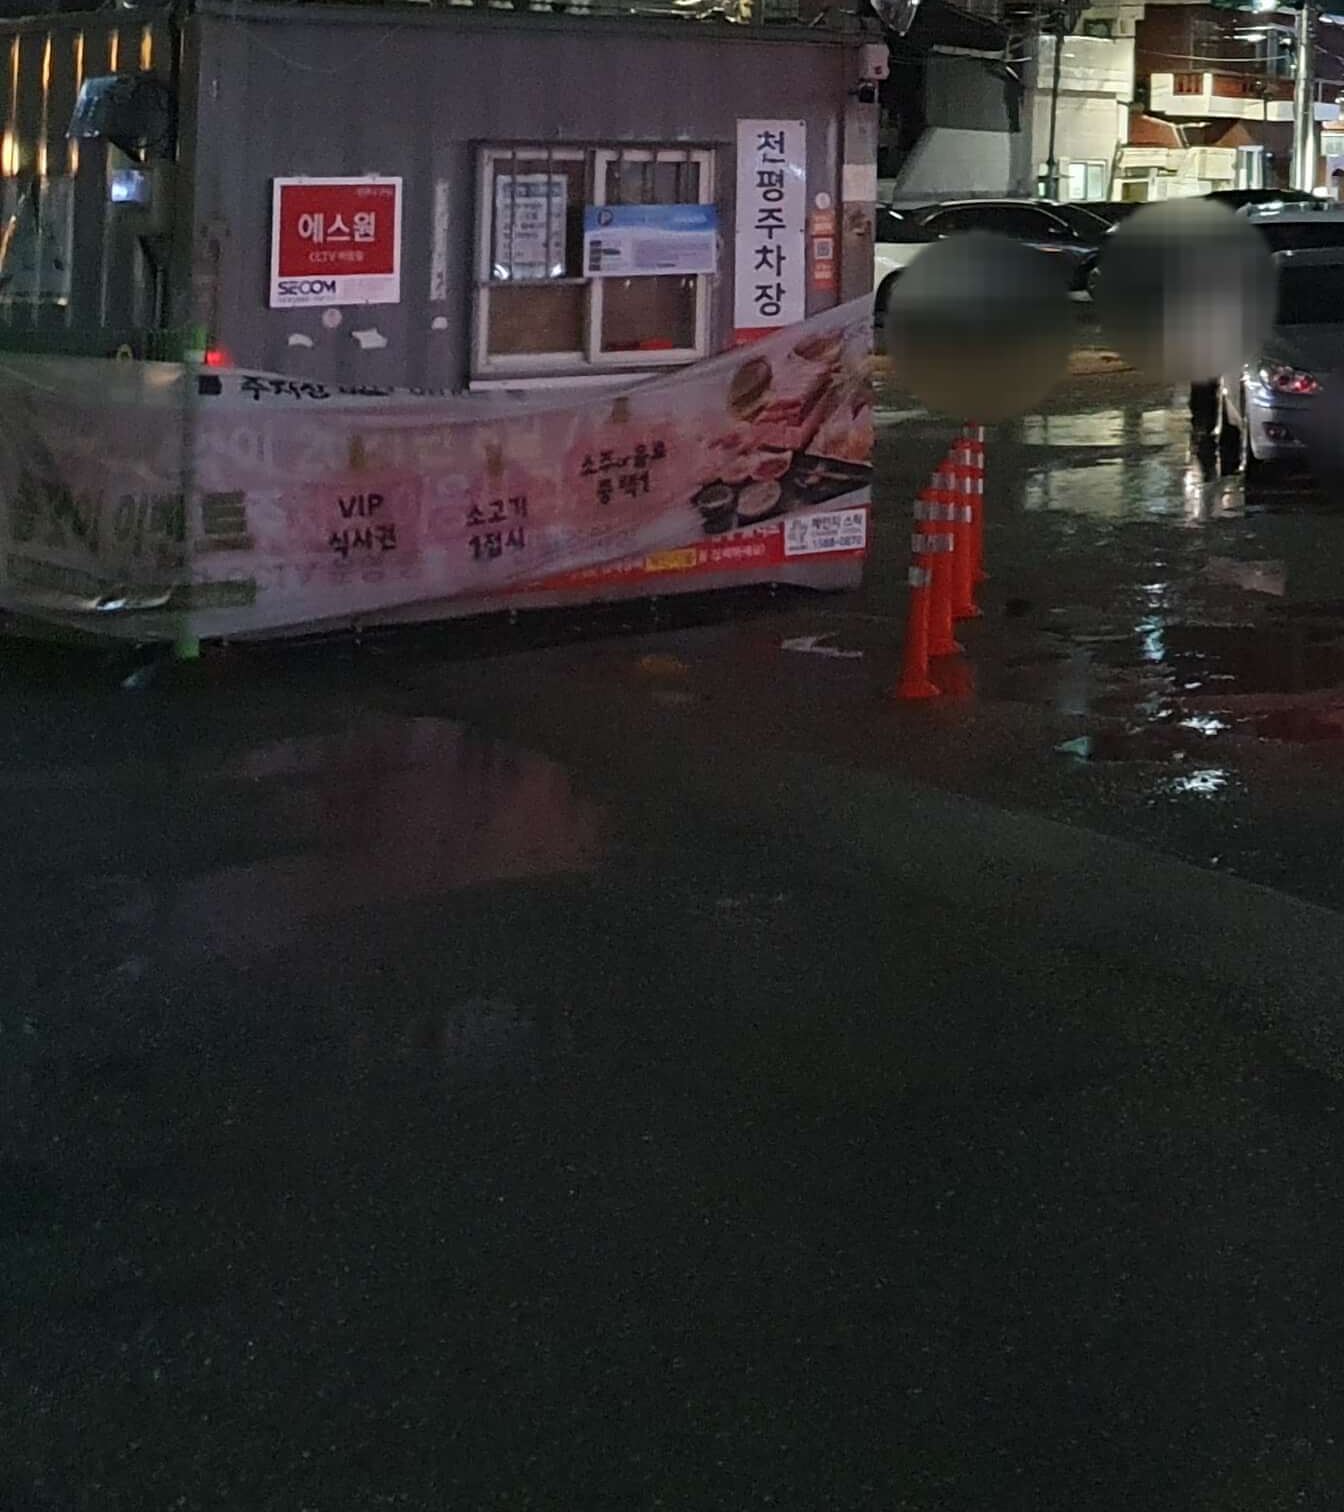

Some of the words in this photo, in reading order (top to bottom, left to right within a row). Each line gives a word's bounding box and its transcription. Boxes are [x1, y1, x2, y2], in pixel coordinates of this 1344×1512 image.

[298, 211, 376, 243] 에스원
[754, 130, 787, 317] 천평주차장
[278, 280, 336, 295] SECOM
[338, 493, 384, 519] VIP
[329, 523, 397, 559] 식사권
